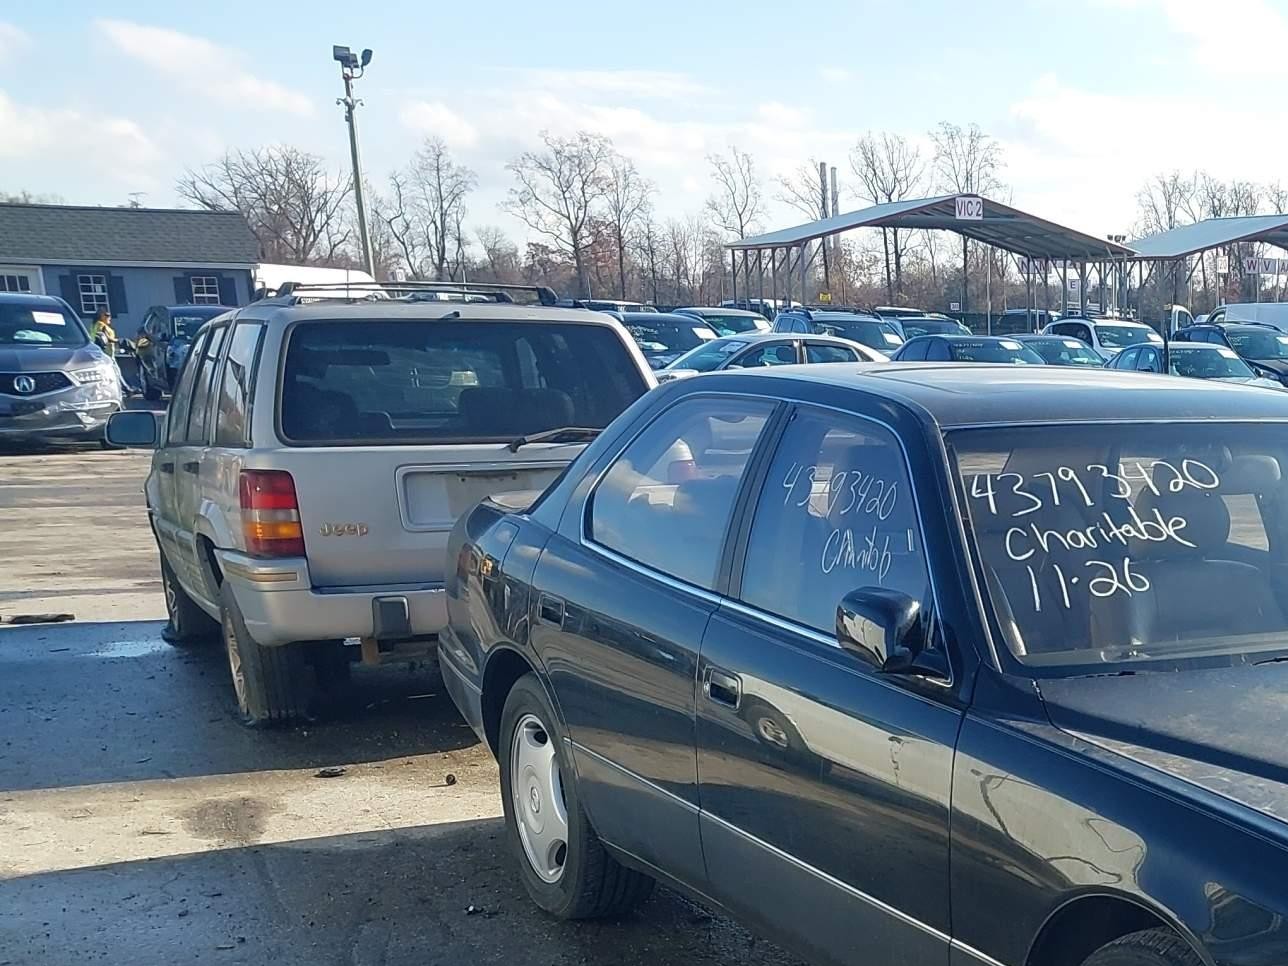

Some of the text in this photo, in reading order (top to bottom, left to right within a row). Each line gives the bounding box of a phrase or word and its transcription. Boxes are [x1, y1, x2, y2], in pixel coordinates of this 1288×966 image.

[956, 200, 982, 217] VIC 2
[1247, 260, 1257, 271] W
[1263, 260, 1271, 271] V
[970, 459, 1220, 517] 43793420
[319, 521, 369, 537] Jeep
[1005, 506, 1198, 561] Charitable
